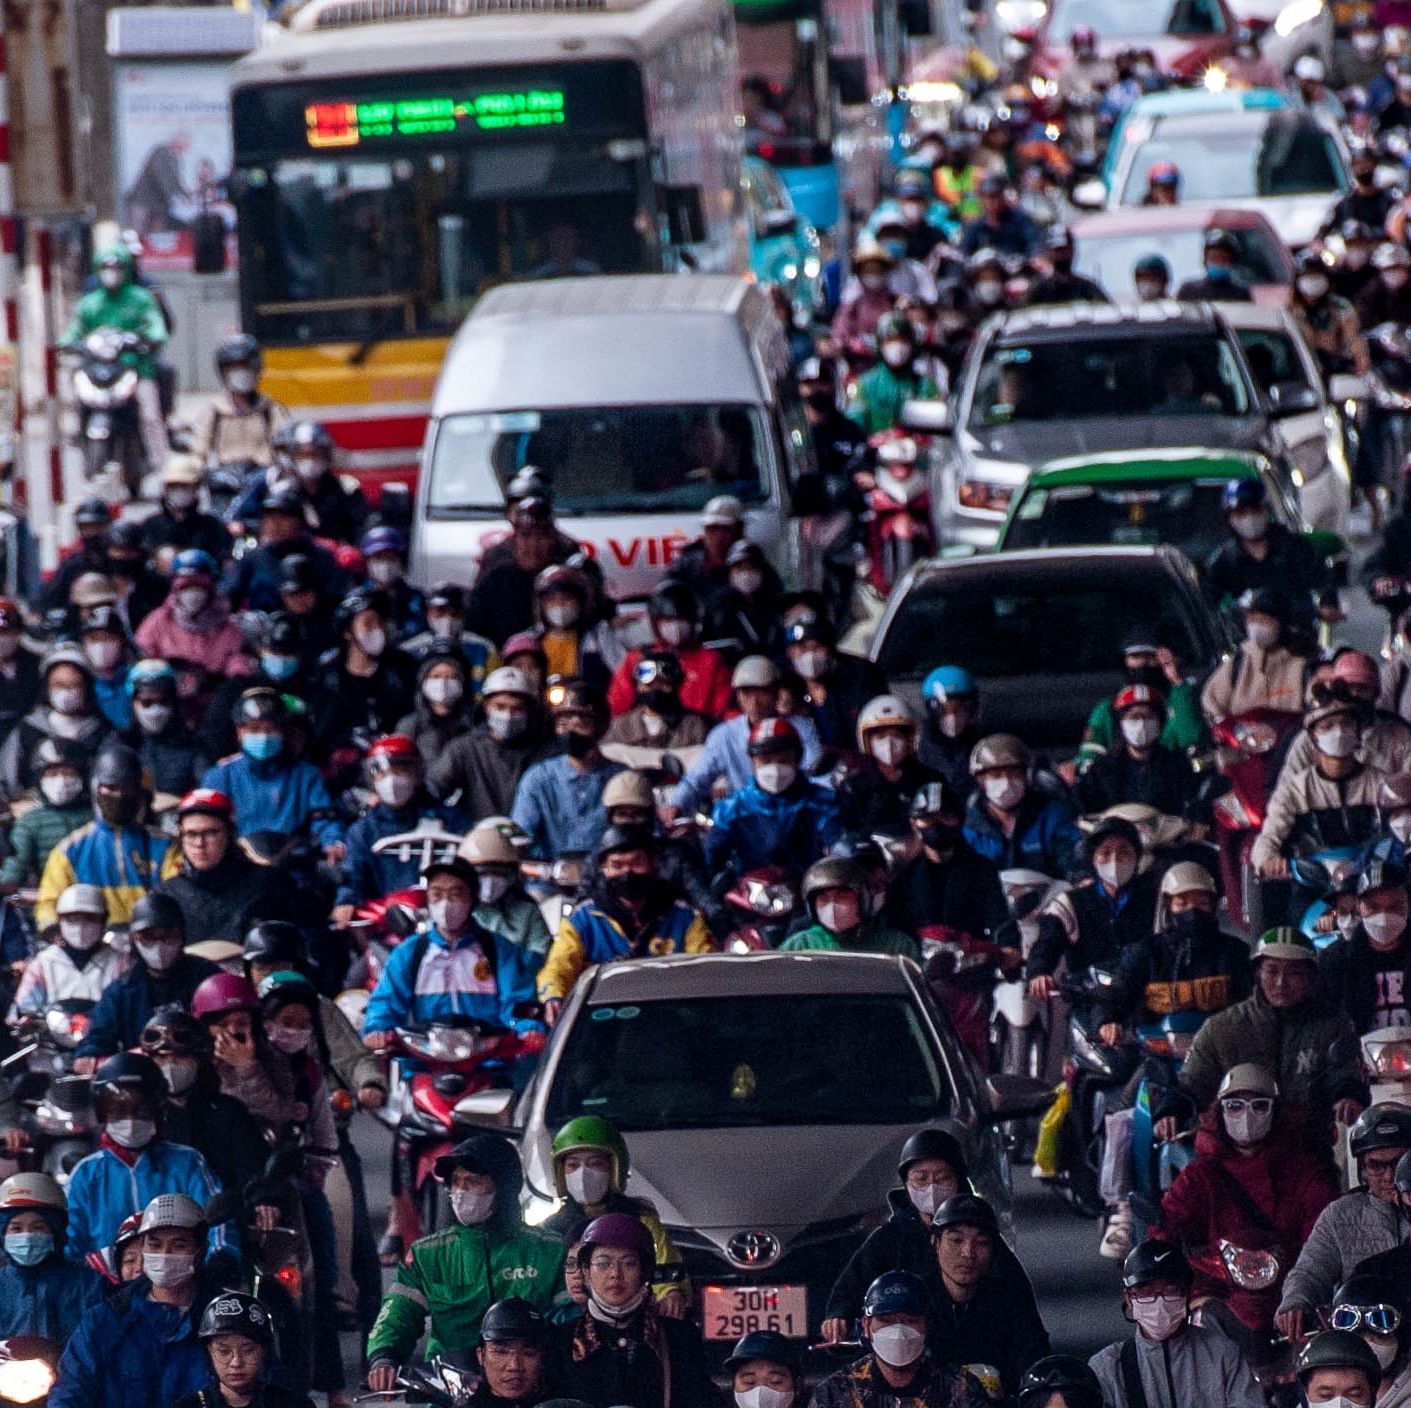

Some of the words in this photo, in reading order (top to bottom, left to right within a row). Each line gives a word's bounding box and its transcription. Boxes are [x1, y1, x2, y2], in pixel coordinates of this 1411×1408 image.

[502, 1265, 538, 1281] Grab
[733, 1290, 778, 1312] 30H
[715, 1314, 794, 1338] 29861
